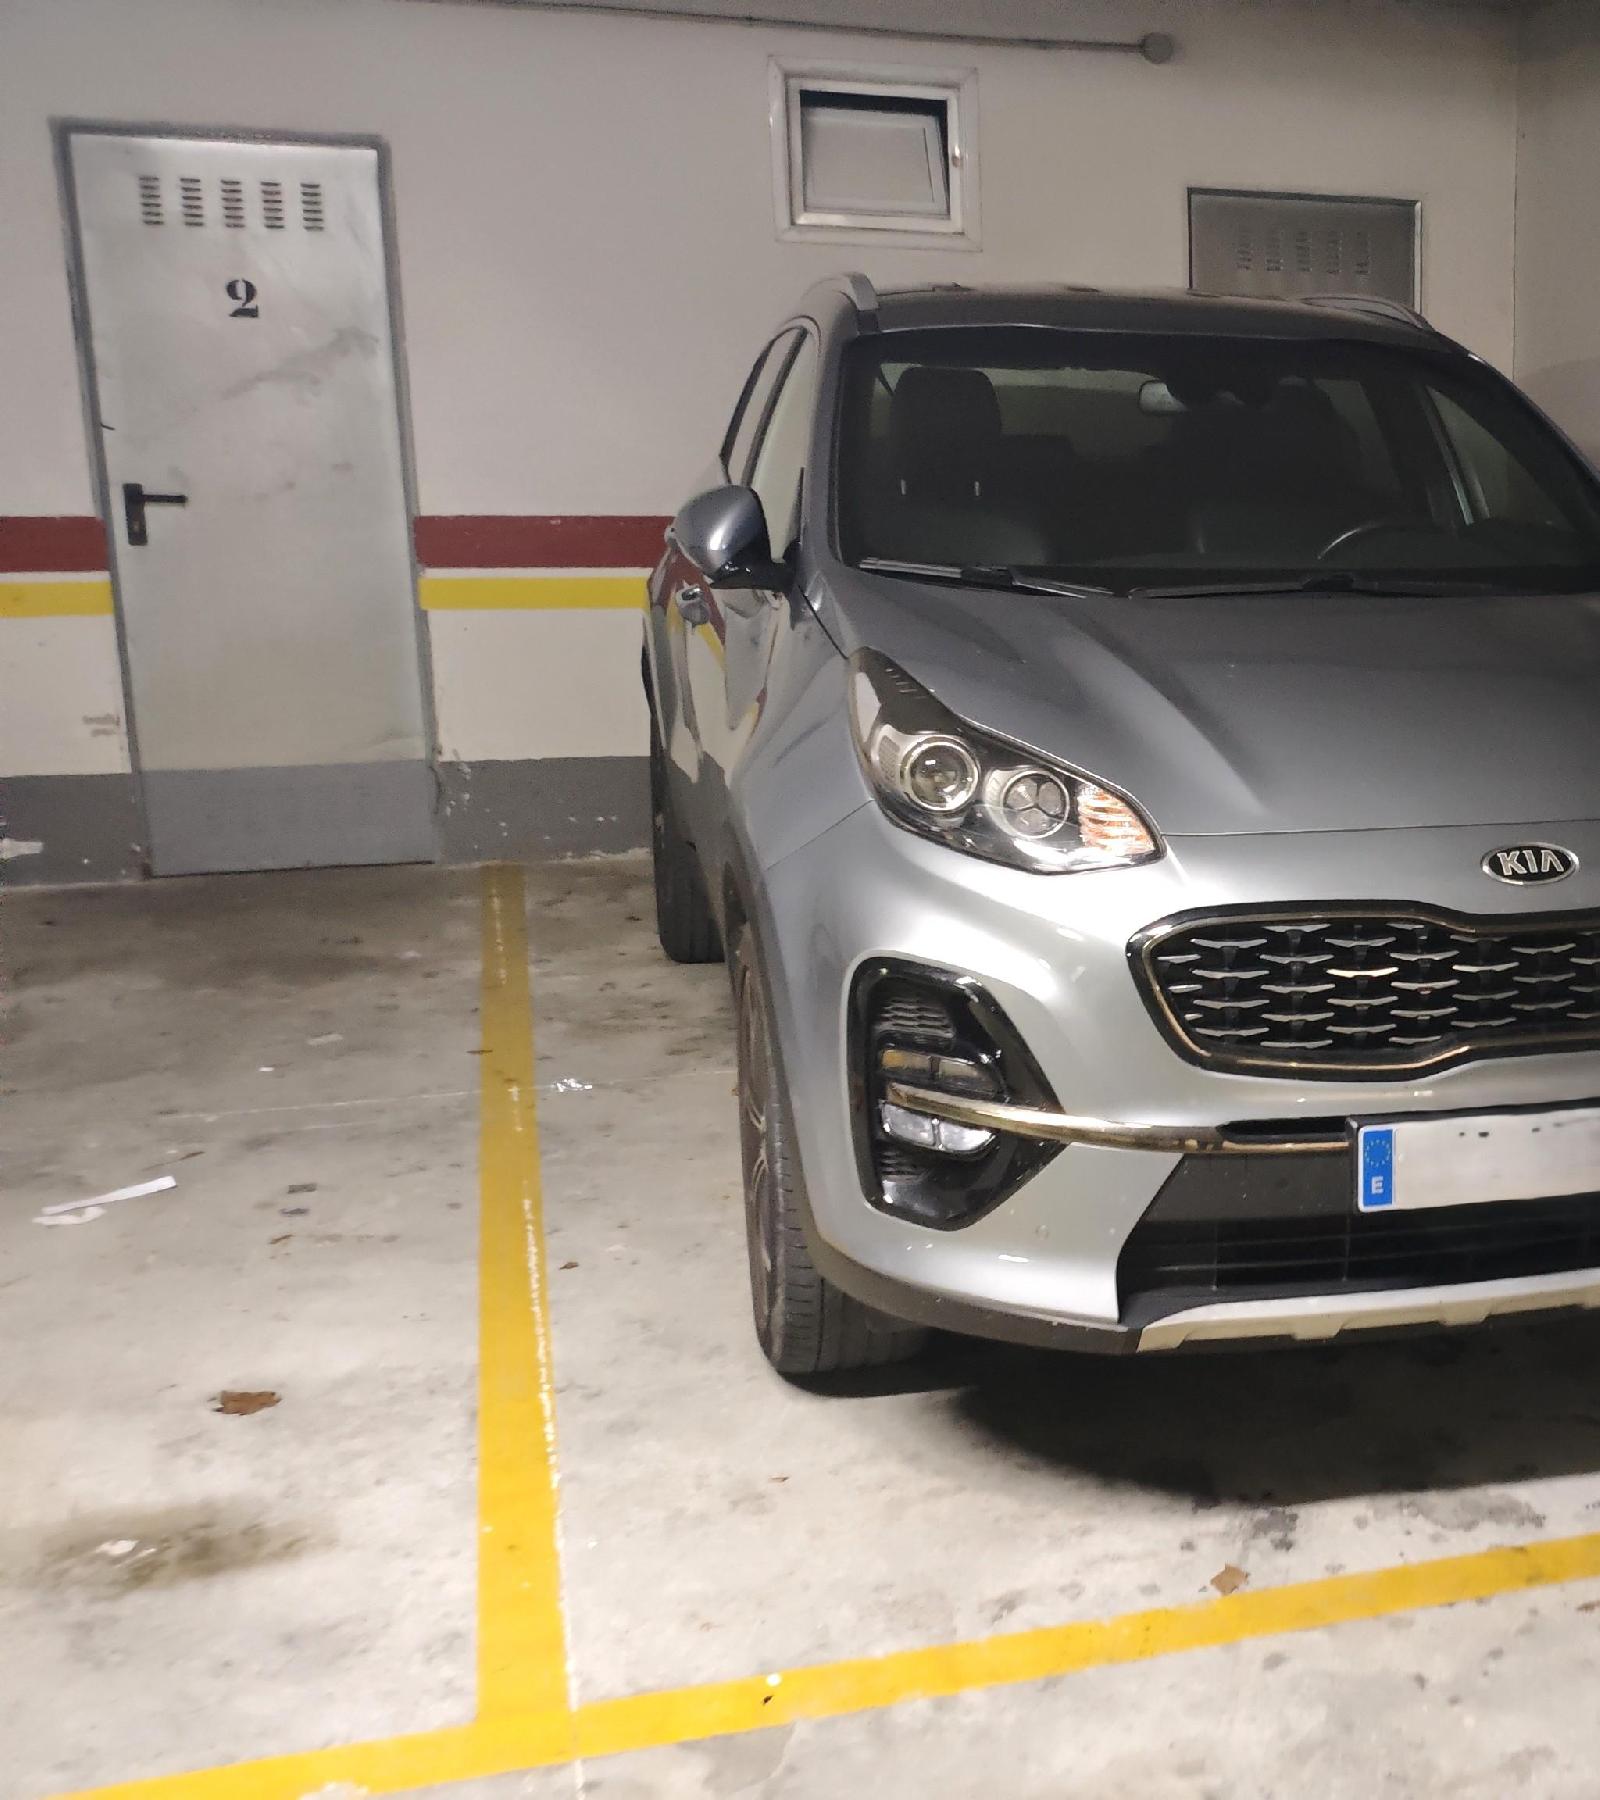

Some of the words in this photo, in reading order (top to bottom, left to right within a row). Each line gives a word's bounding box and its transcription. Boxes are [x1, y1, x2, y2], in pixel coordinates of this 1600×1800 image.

[226, 278, 259, 318] 2
[1497, 849, 1565, 876] KIA
[1371, 1175, 1384, 1195] E
